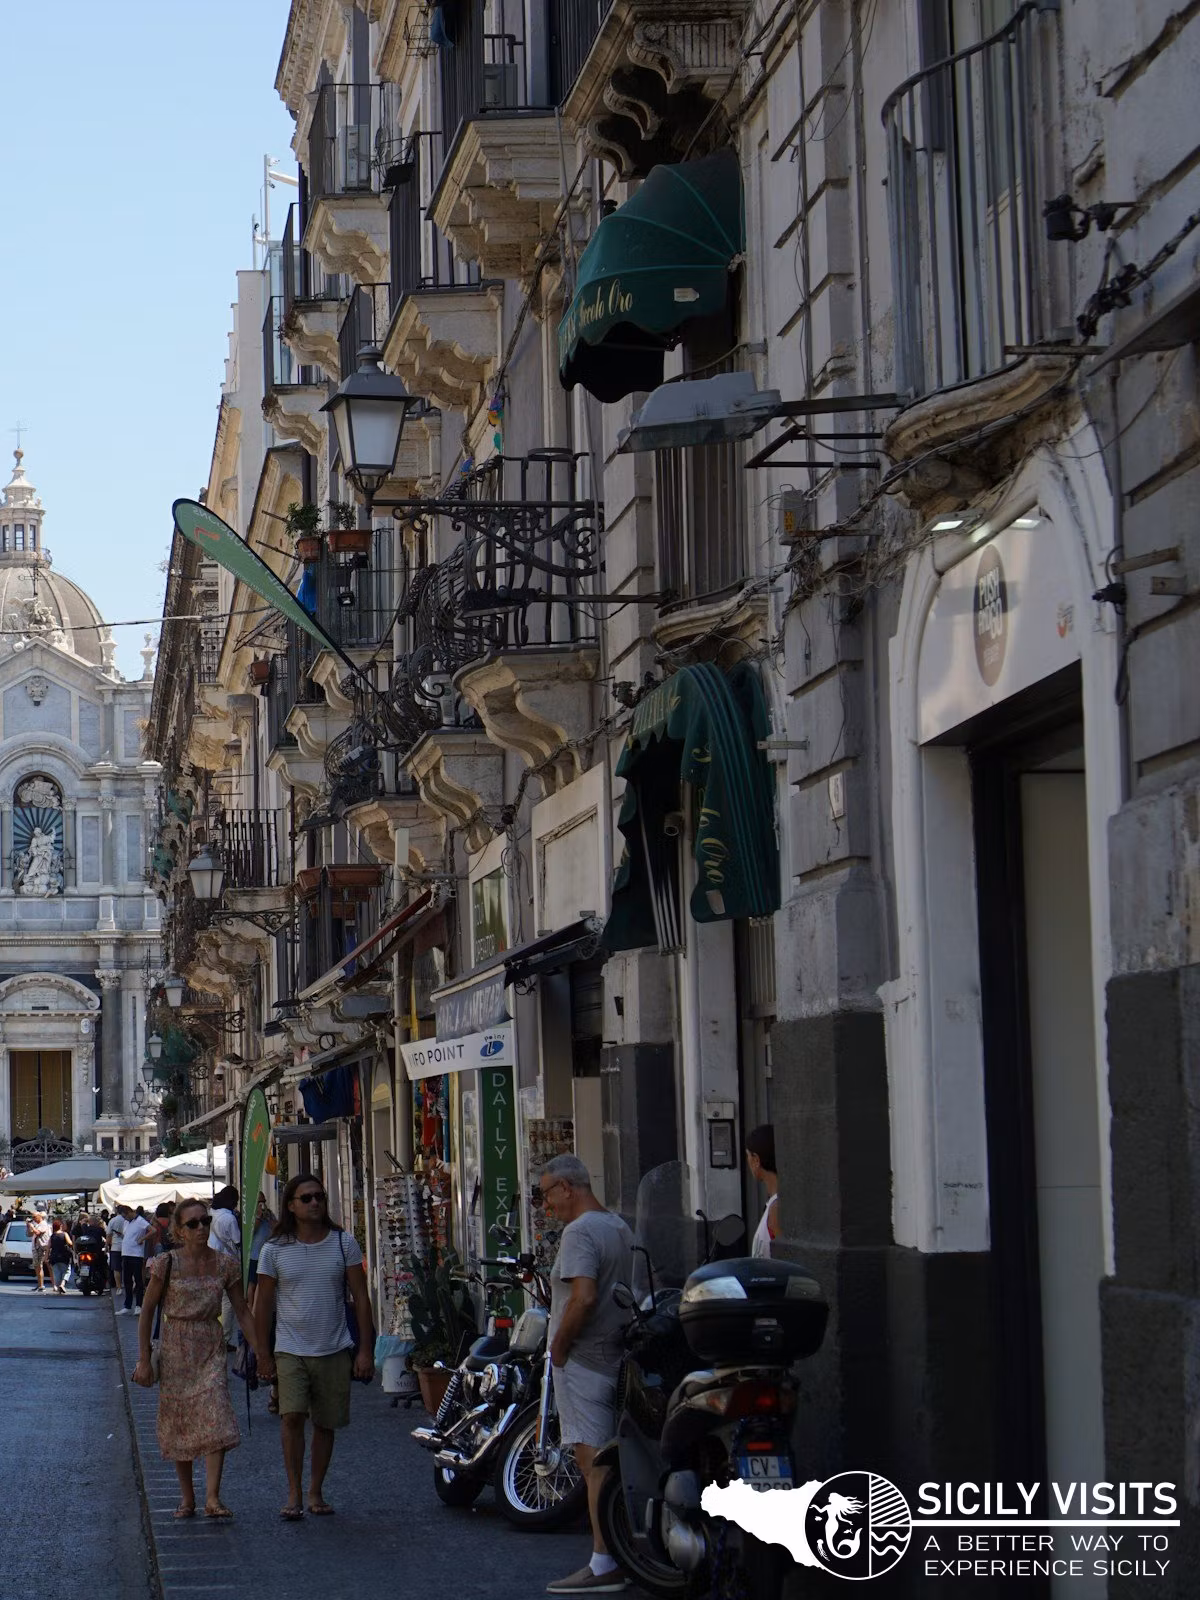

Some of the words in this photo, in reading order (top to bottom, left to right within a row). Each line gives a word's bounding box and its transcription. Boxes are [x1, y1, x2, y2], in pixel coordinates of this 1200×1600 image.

[608, 278, 634, 316] Oro
[427, 1044, 465, 1064] POINT
[492, 1073, 508, 1160] DAILY
